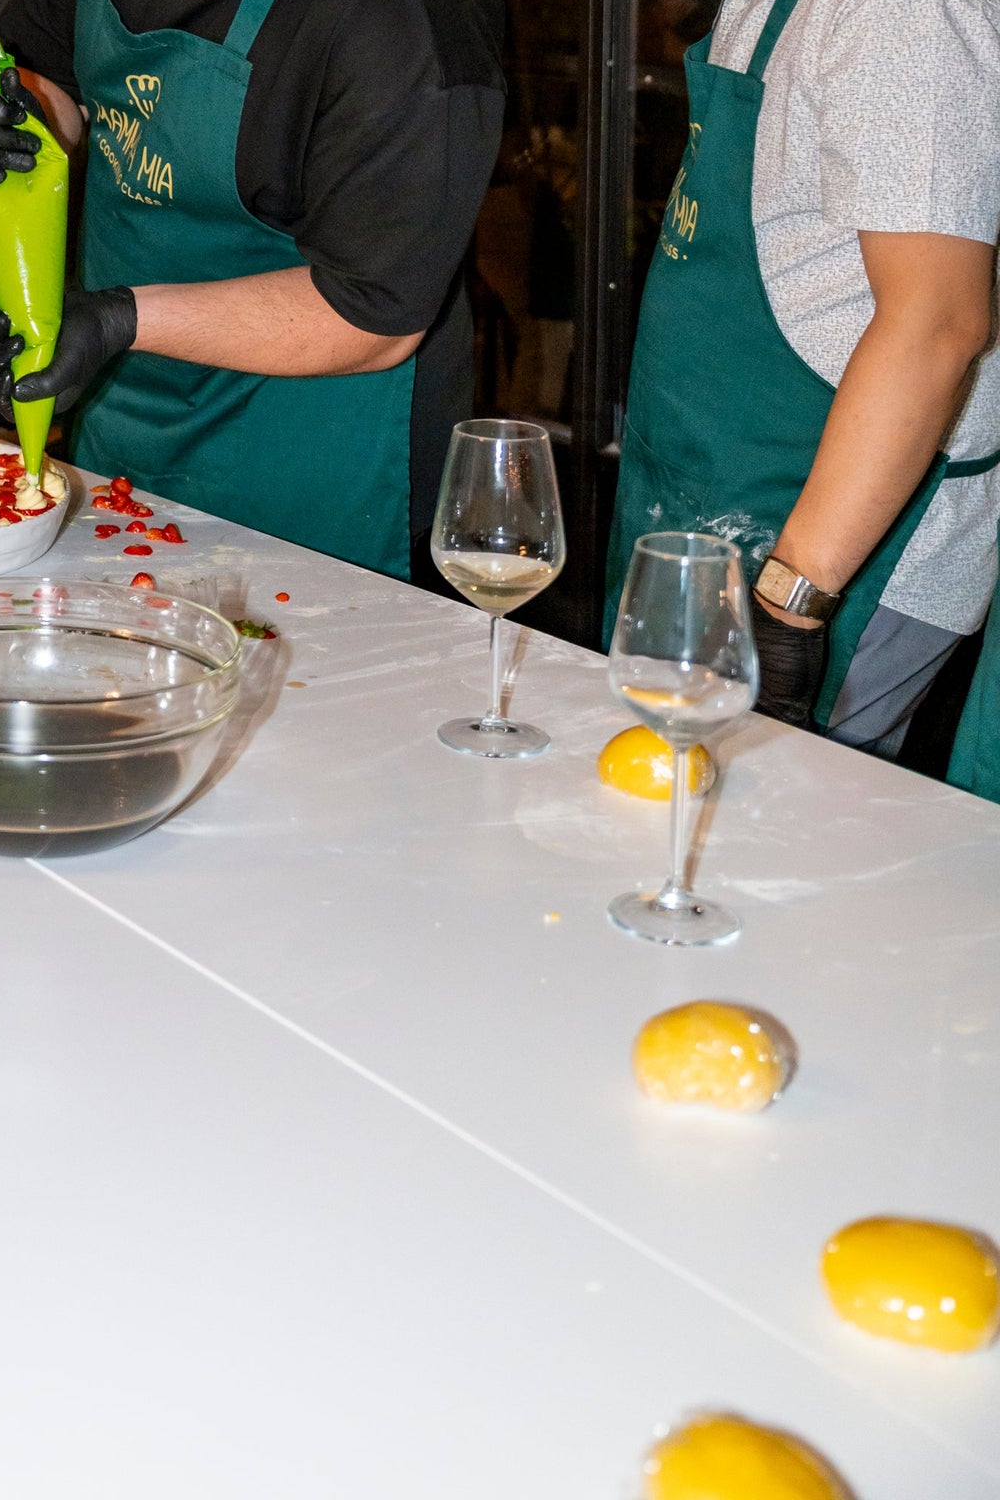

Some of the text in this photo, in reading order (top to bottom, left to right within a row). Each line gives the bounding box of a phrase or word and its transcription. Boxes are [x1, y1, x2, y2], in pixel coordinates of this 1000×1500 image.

[120, 182, 163, 206] CLASS
[137, 146, 174, 200] MIA
[671, 194, 699, 243] MIA
